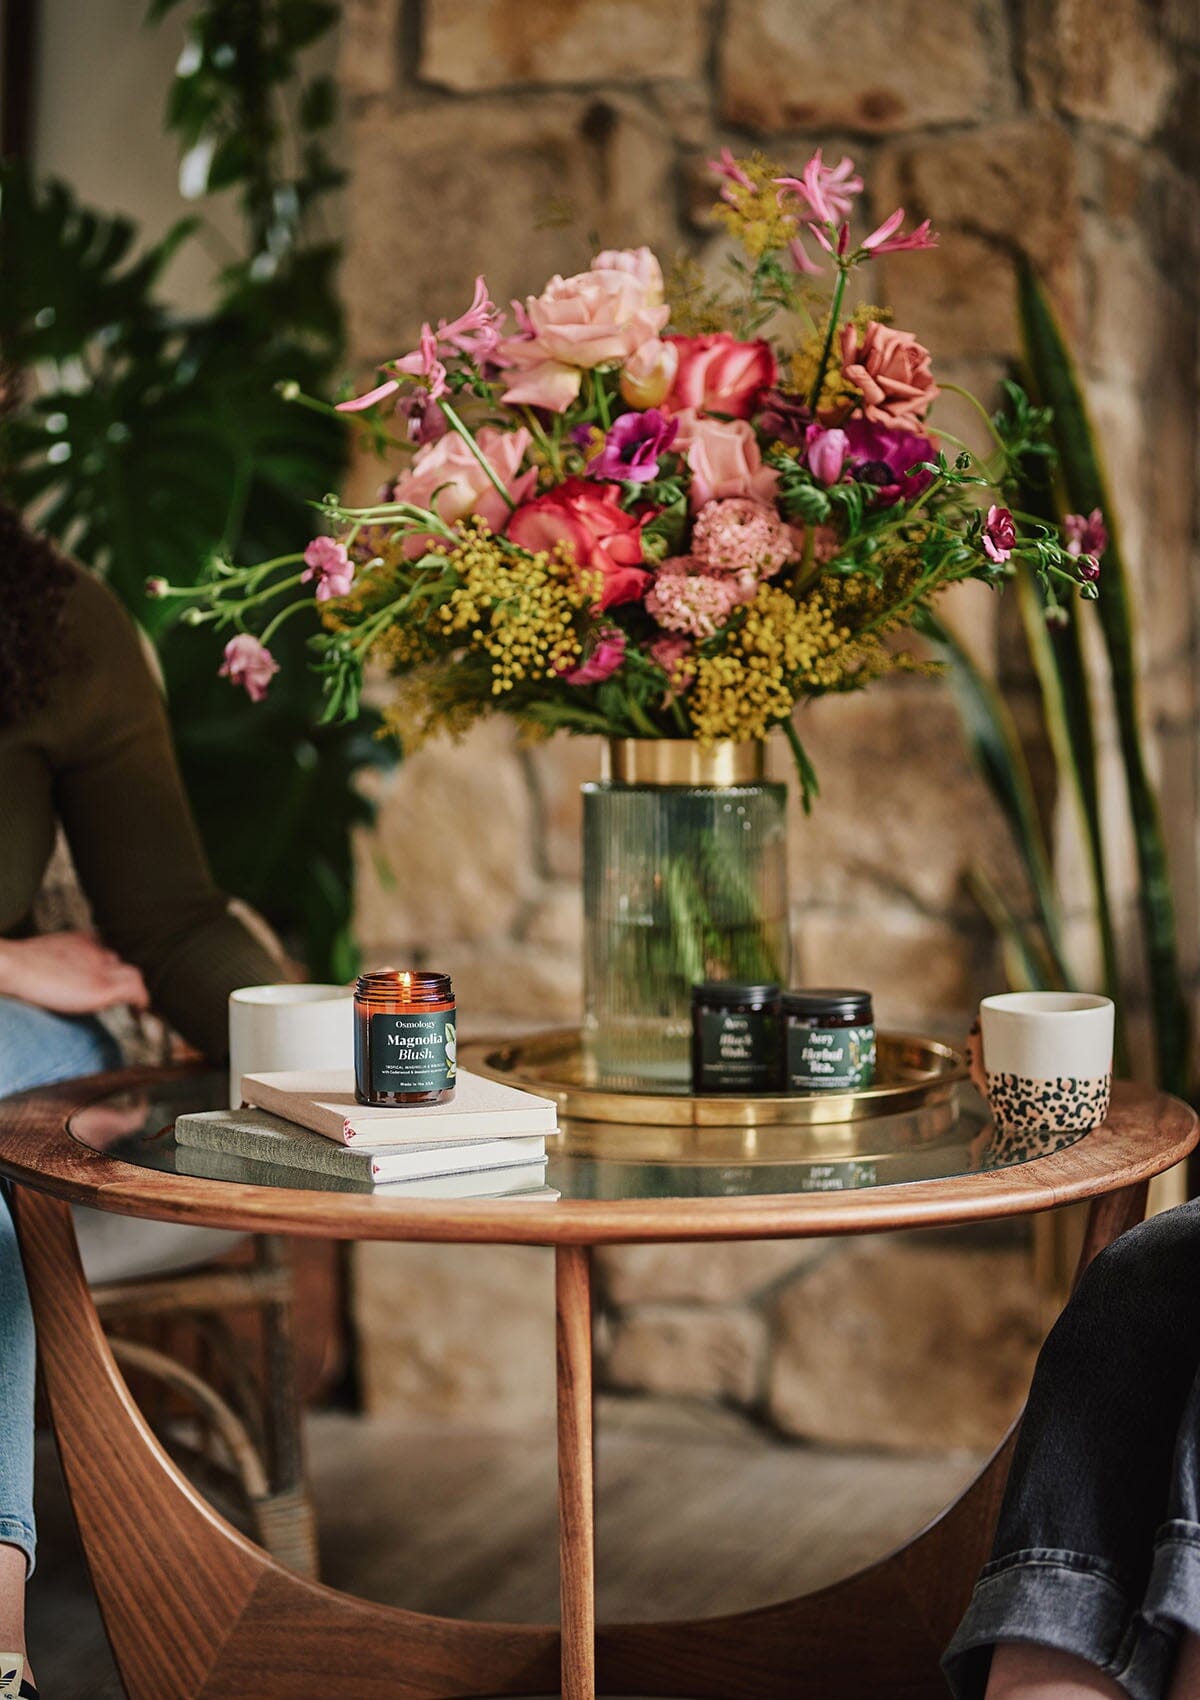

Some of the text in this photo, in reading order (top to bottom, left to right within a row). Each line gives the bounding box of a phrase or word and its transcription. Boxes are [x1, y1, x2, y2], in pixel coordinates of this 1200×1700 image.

[395, 1020, 435, 1029] Osmology
[387, 1032, 443, 1048] Magnolia
[398, 1047, 435, 1060] Blush.
